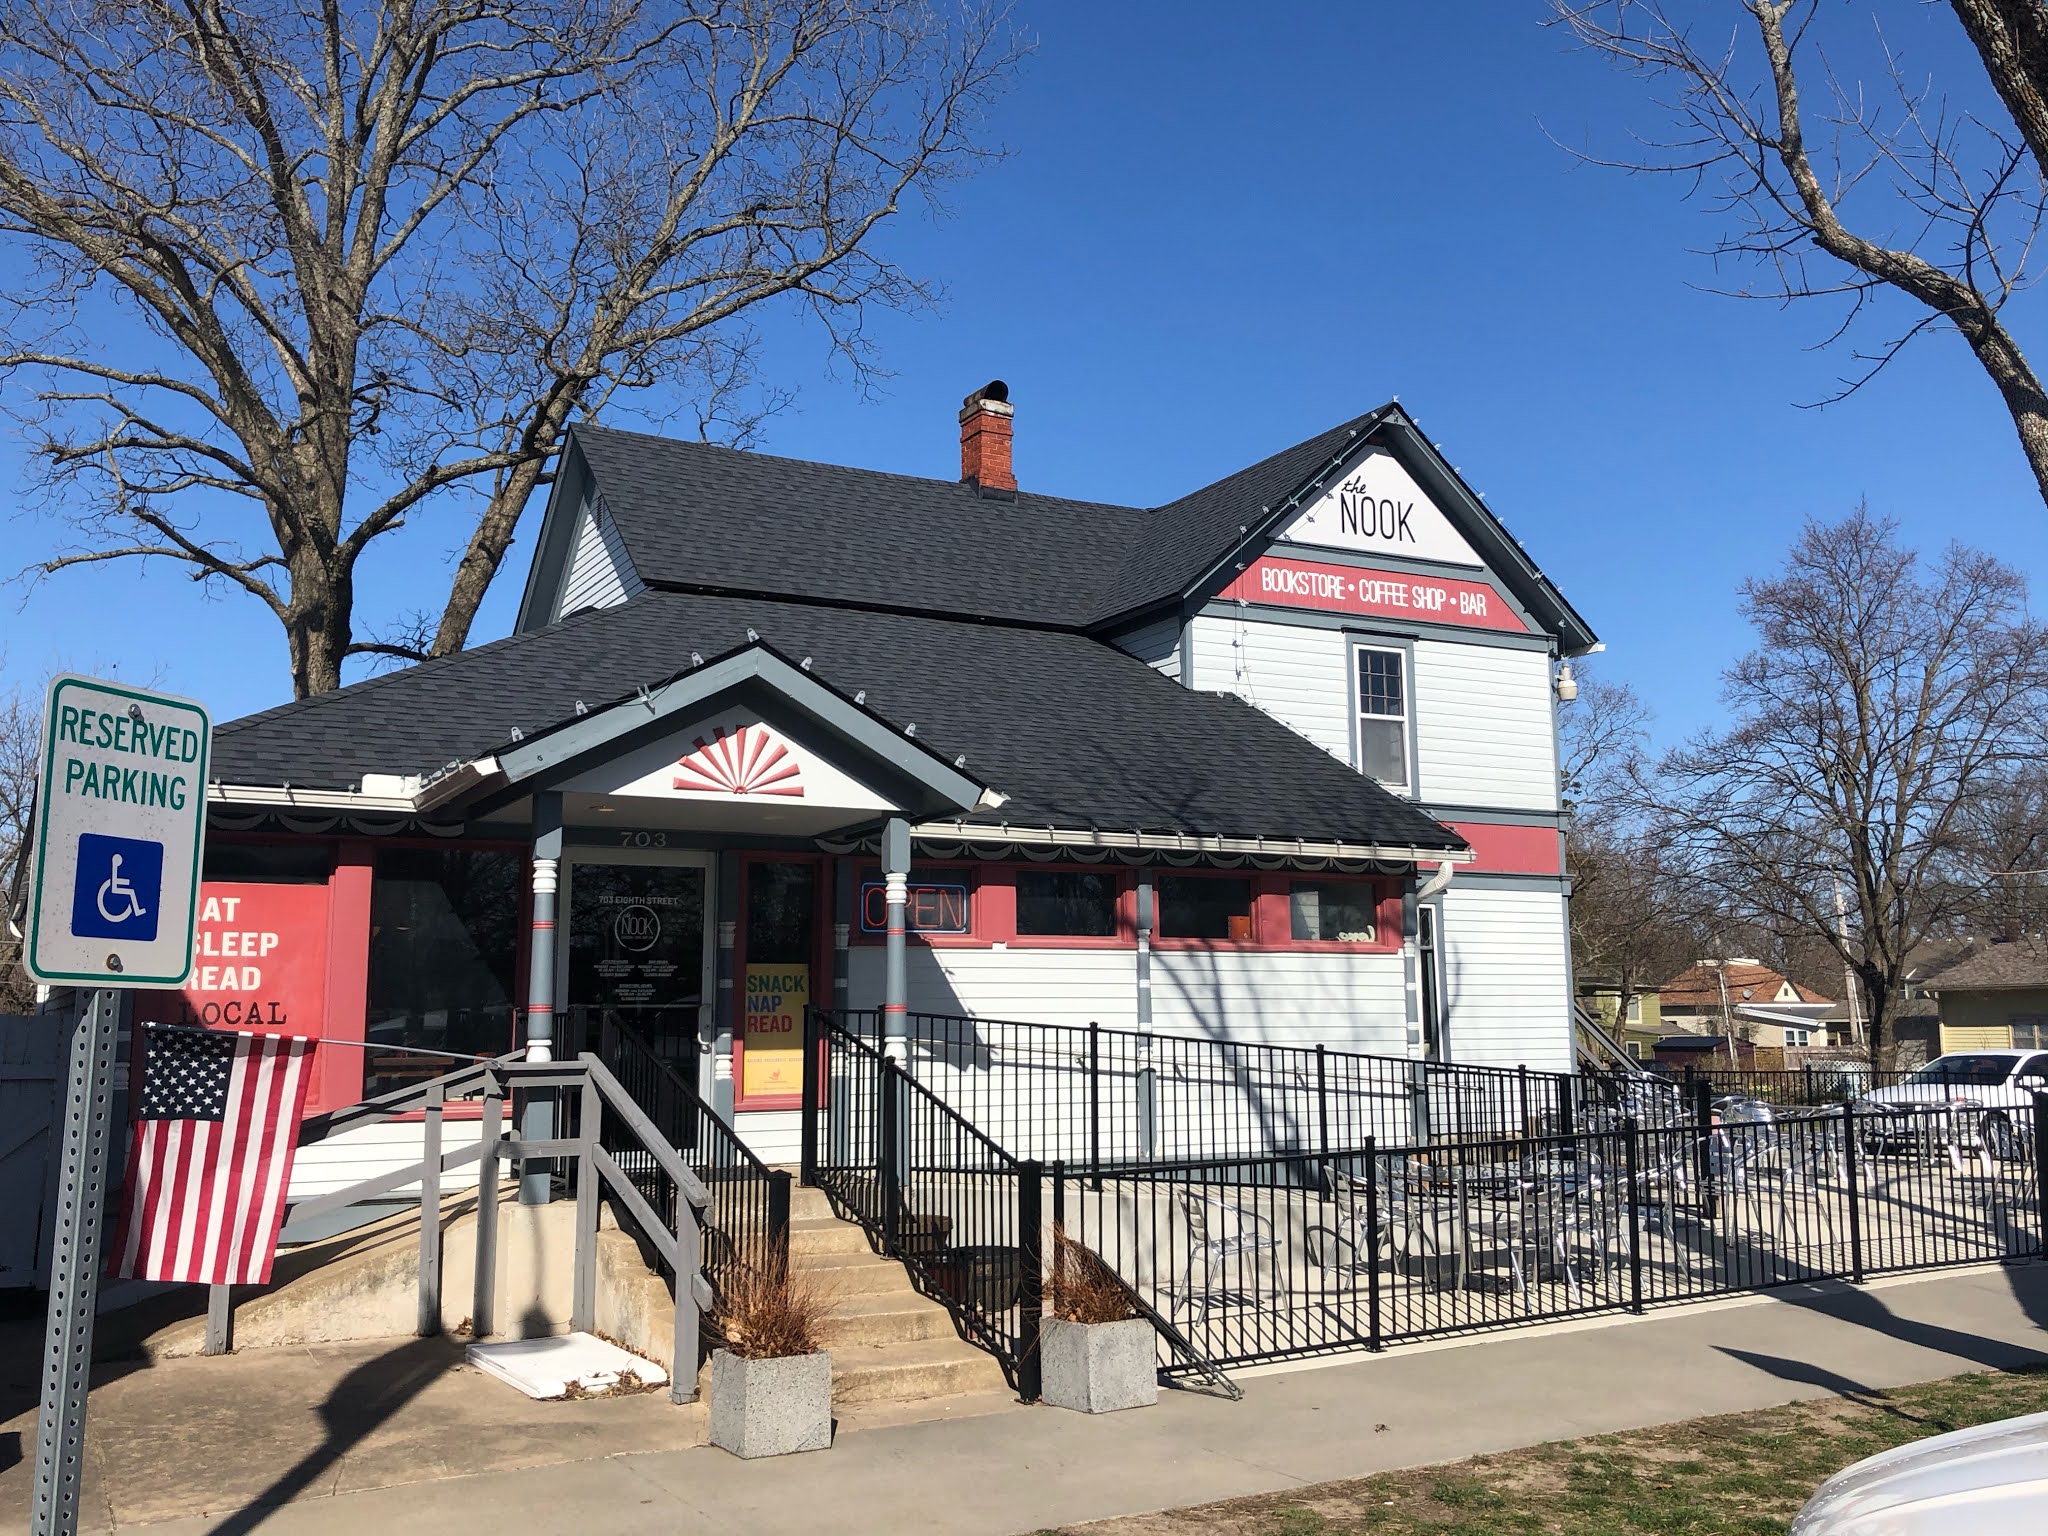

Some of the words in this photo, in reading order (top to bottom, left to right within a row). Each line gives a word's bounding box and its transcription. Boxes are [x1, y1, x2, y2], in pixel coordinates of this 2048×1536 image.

[1341, 475, 1367, 494] the
[1340, 493, 1416, 544] NOOK
[1261, 566, 1346, 600] BOOKSTORE
[1359, 578, 1409, 608] COFFEE
[1412, 587, 1447, 612] SHOP
[1459, 591, 1487, 617] BAR
[60, 705, 198, 764] RESERVED
[65, 758, 187, 811] PARKING
[620, 831, 667, 848] 703
[198, 897, 241, 922] AT
[598, 896, 614, 904] 703
[615, 896, 645, 905] EIGHTH
[646, 897, 678, 905] STREET
[621, 916, 654, 935] NOOK
[747, 975, 806, 993] SNACK
[178, 1001, 287, 1025] LOCAL
[747, 995, 782, 1013] NAP
[747, 1015, 793, 1033] READ
